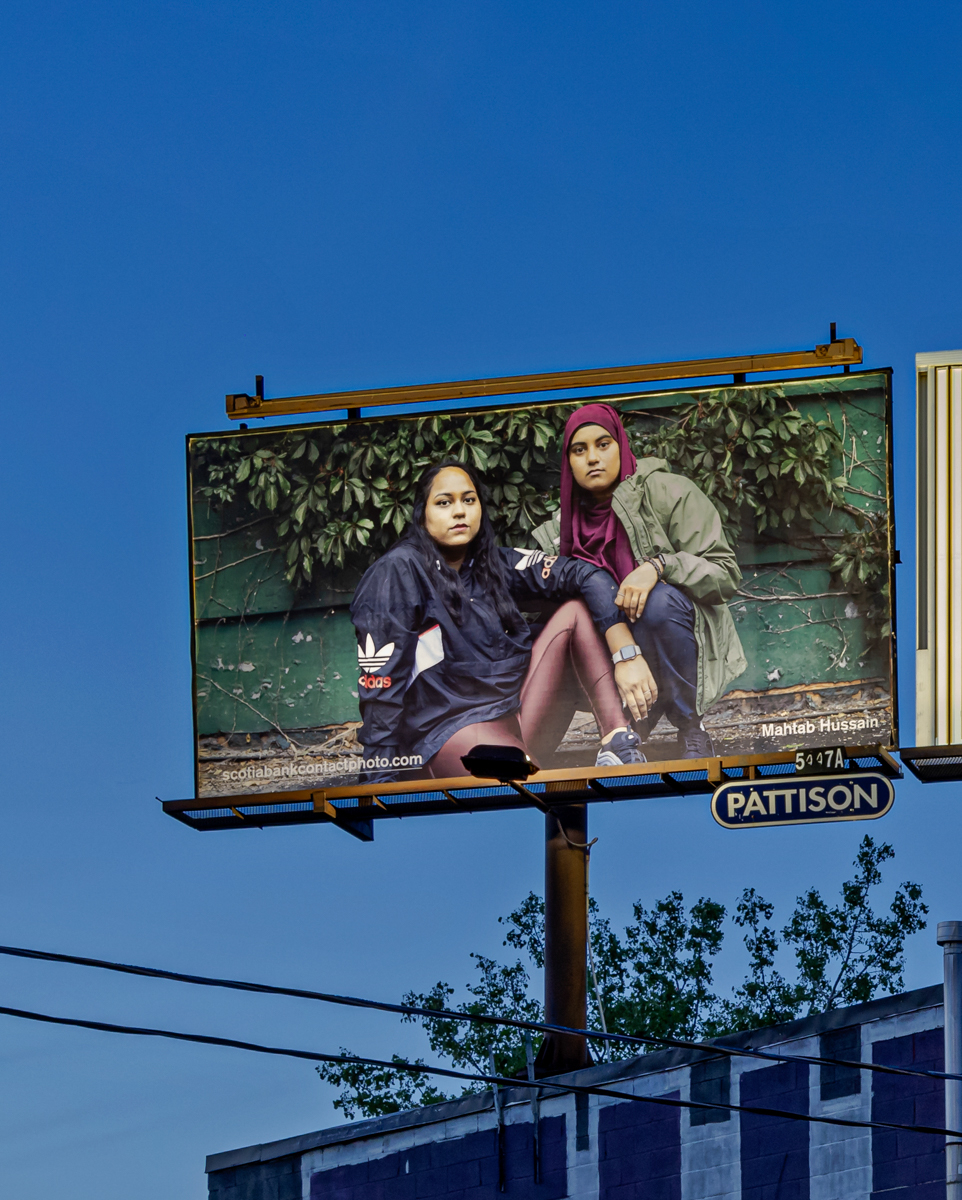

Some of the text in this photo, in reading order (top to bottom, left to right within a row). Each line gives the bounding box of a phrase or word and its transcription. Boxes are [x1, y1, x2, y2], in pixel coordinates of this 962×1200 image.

[358, 674, 392, 688] adas
[762, 718, 879, 737] Mahtab Hussain
[222, 754, 423, 781] scotiabankcontactphoto.com
[727, 783, 878, 818] PATTISON
